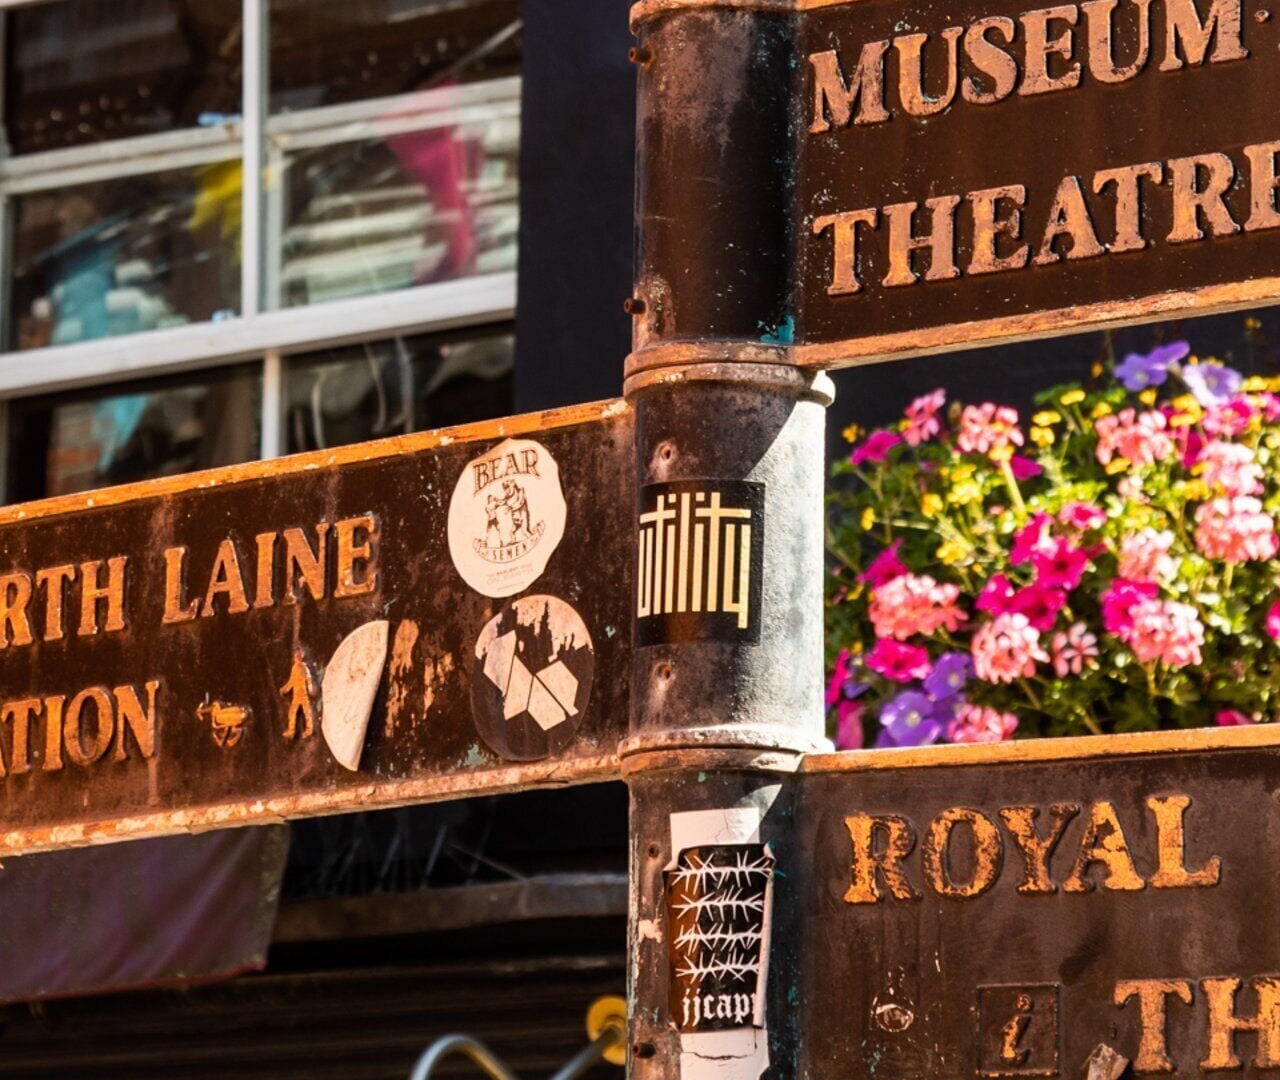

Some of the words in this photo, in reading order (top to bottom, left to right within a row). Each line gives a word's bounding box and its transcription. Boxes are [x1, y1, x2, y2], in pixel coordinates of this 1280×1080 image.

[472, 448, 542, 498] BEAR
[161, 514, 379, 625] LAINE
[843, 793, 1223, 903] ROYAL
